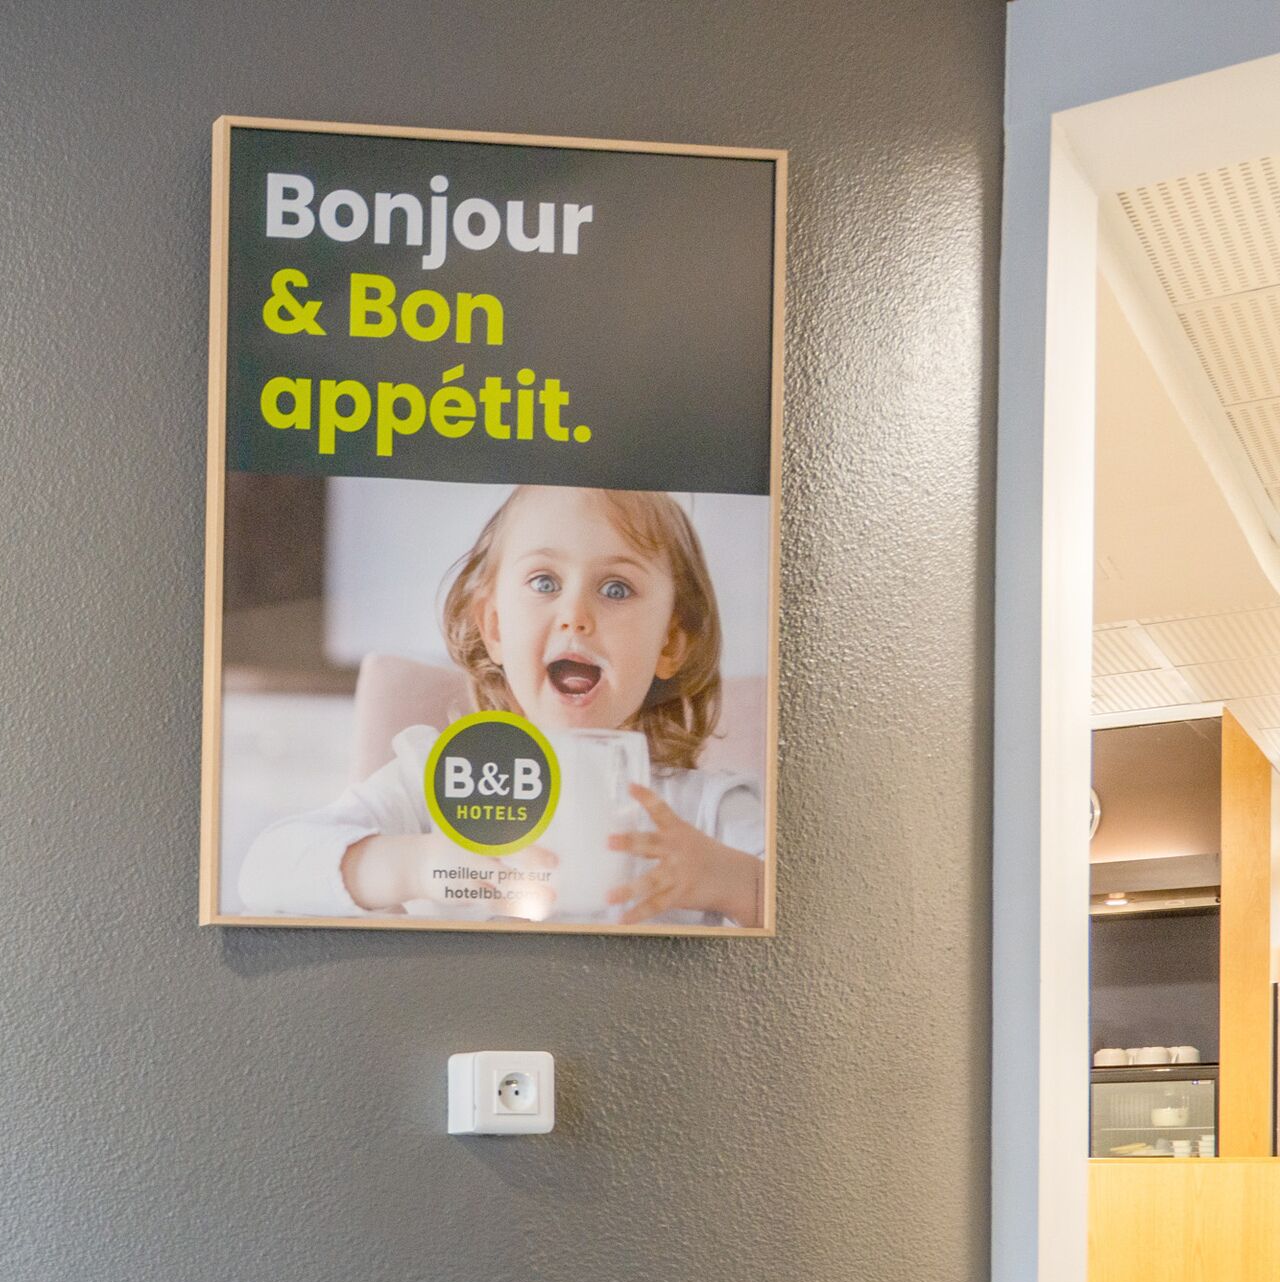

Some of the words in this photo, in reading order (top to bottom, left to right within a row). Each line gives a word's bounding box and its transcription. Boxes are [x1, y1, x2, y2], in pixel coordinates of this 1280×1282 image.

[266, 172, 593, 270] Bonjour
[262, 268, 327, 336] &
[349, 273, 504, 345] Bon
[260, 363, 592, 456] appétit.
[444, 756, 543, 800] B&B
[456, 805, 528, 820] HOTELS
[432, 867, 494, 880] meilleur
[498, 868, 525, 883] prix
[528, 872, 552, 881] sur
